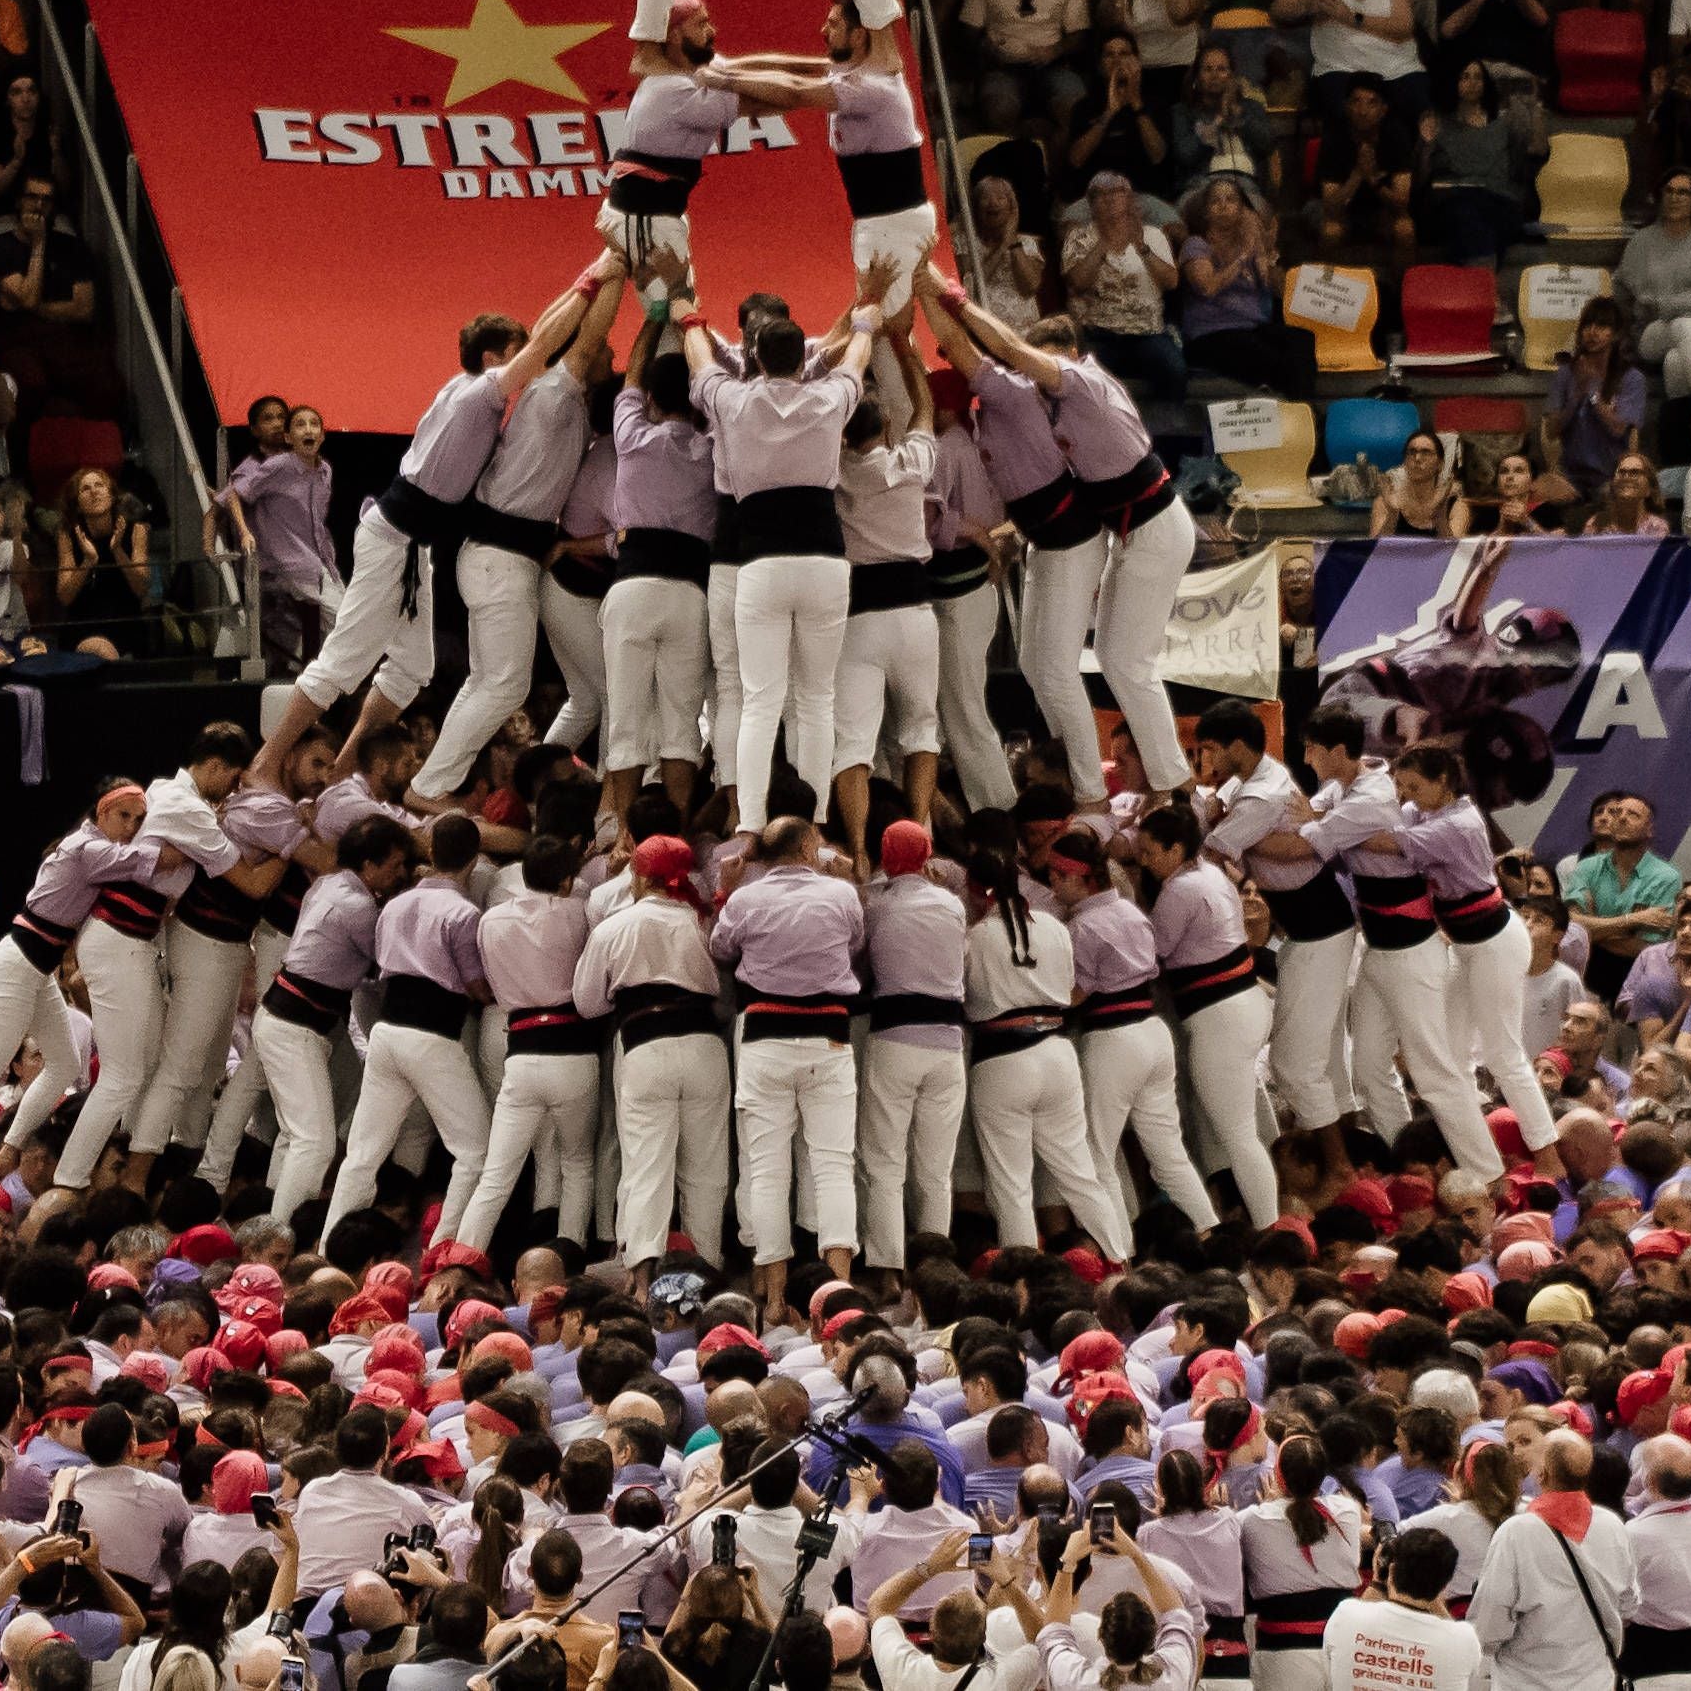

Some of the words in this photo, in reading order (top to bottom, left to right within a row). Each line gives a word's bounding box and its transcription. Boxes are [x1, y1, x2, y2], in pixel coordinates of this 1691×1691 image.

[1575, 651, 1668, 740] A
[1354, 1632, 1404, 1655] Parlem
[1408, 1645, 1426, 1659] de
[1353, 1650, 1434, 1677] castells
[1406, 1678, 1415, 1687] a
